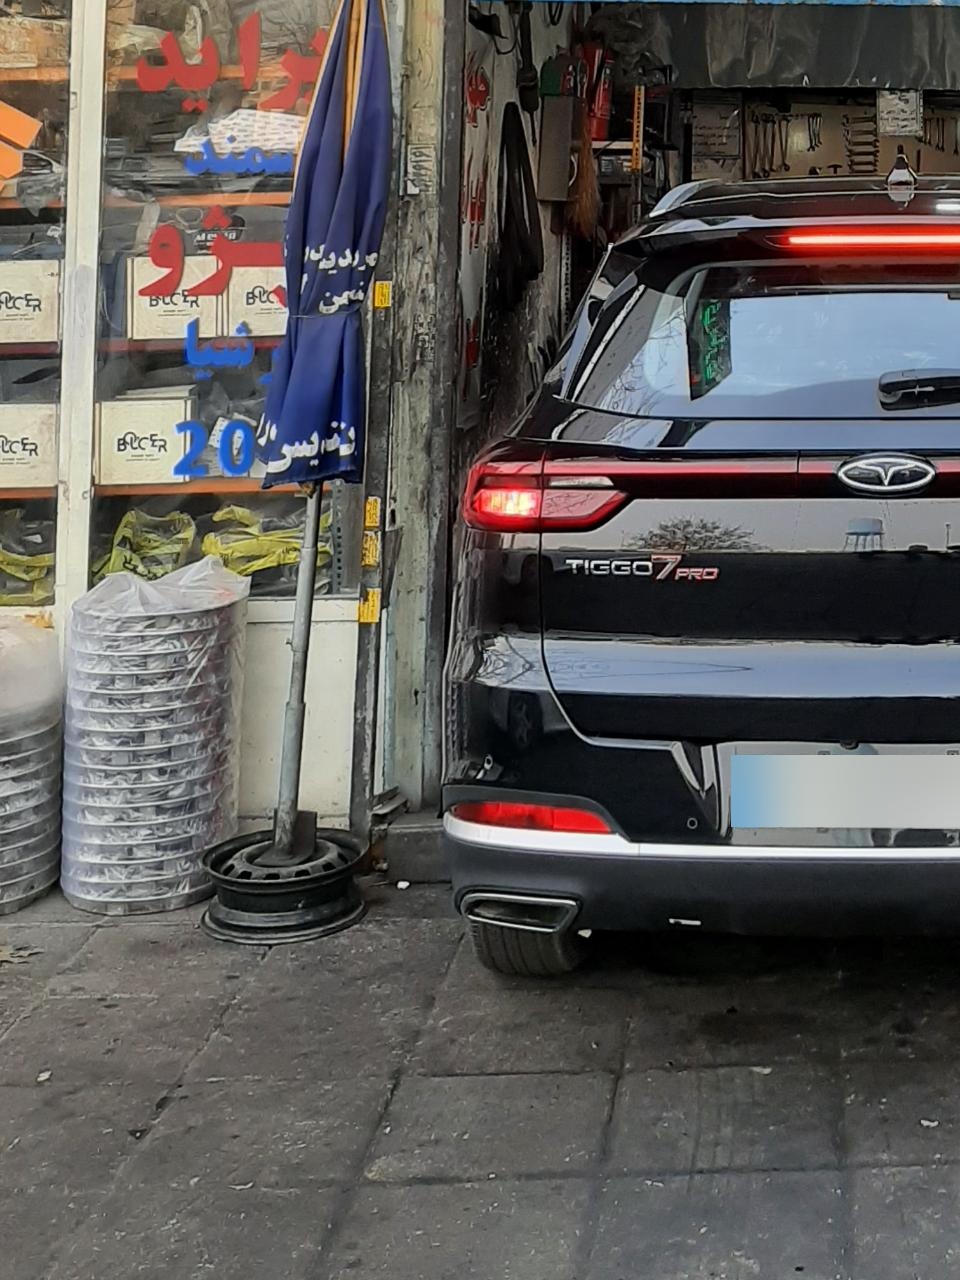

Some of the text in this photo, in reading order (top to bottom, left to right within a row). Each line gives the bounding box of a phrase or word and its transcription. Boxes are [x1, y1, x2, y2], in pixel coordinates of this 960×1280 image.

[565, 554, 719, 581] TIGGO 7 PRO
